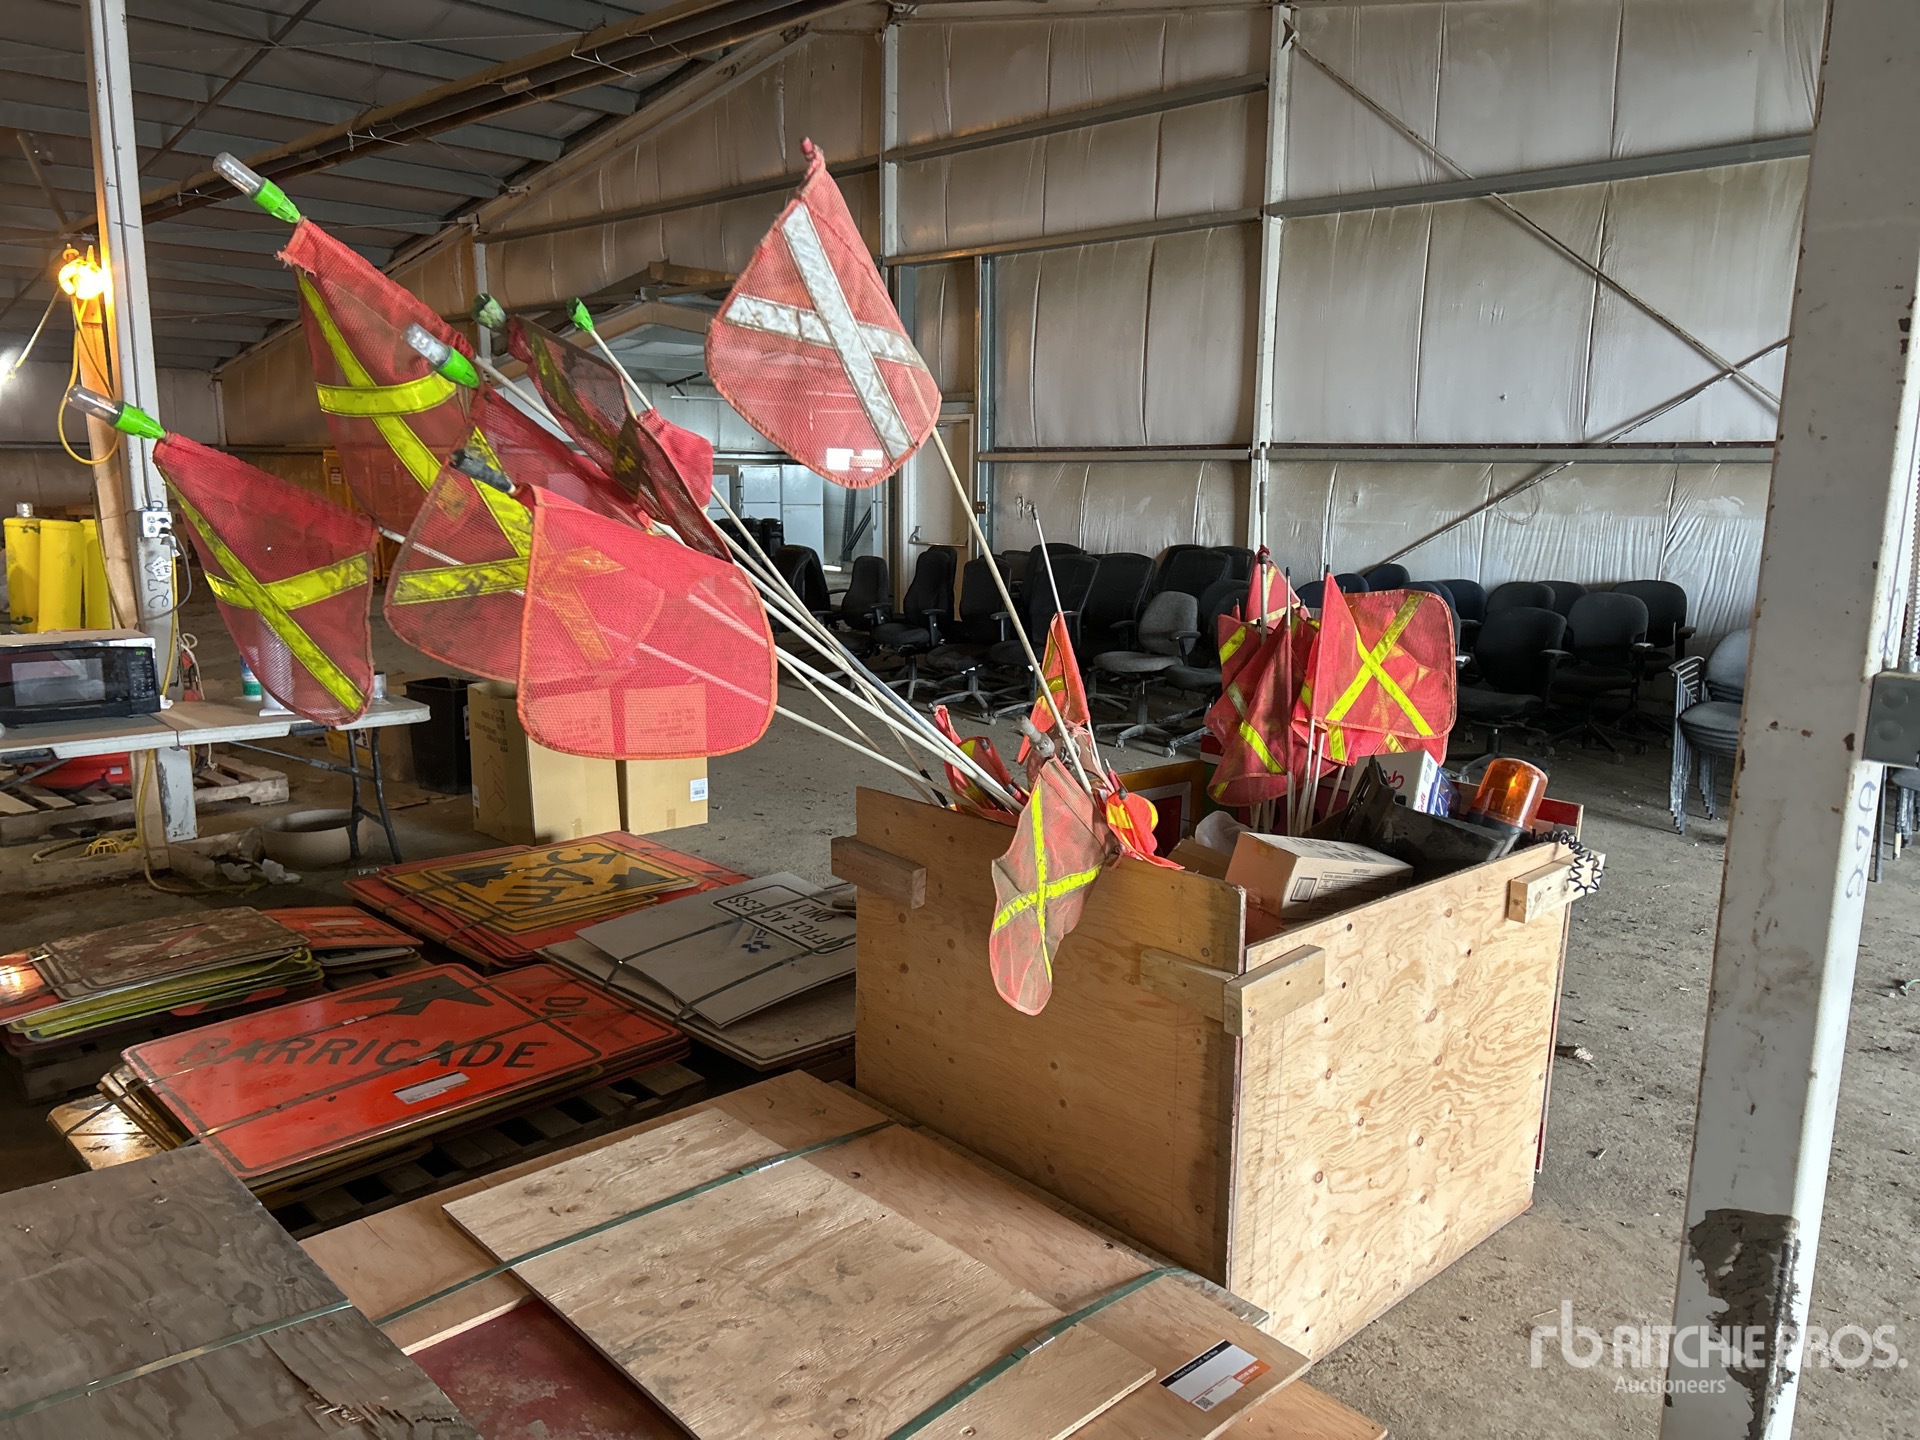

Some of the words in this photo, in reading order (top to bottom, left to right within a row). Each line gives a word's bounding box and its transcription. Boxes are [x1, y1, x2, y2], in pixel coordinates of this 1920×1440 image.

[727, 896, 793, 923] ACESS
[787, 903, 836, 923] ONLY
[174, 1037, 548, 1069] BARRICADE
